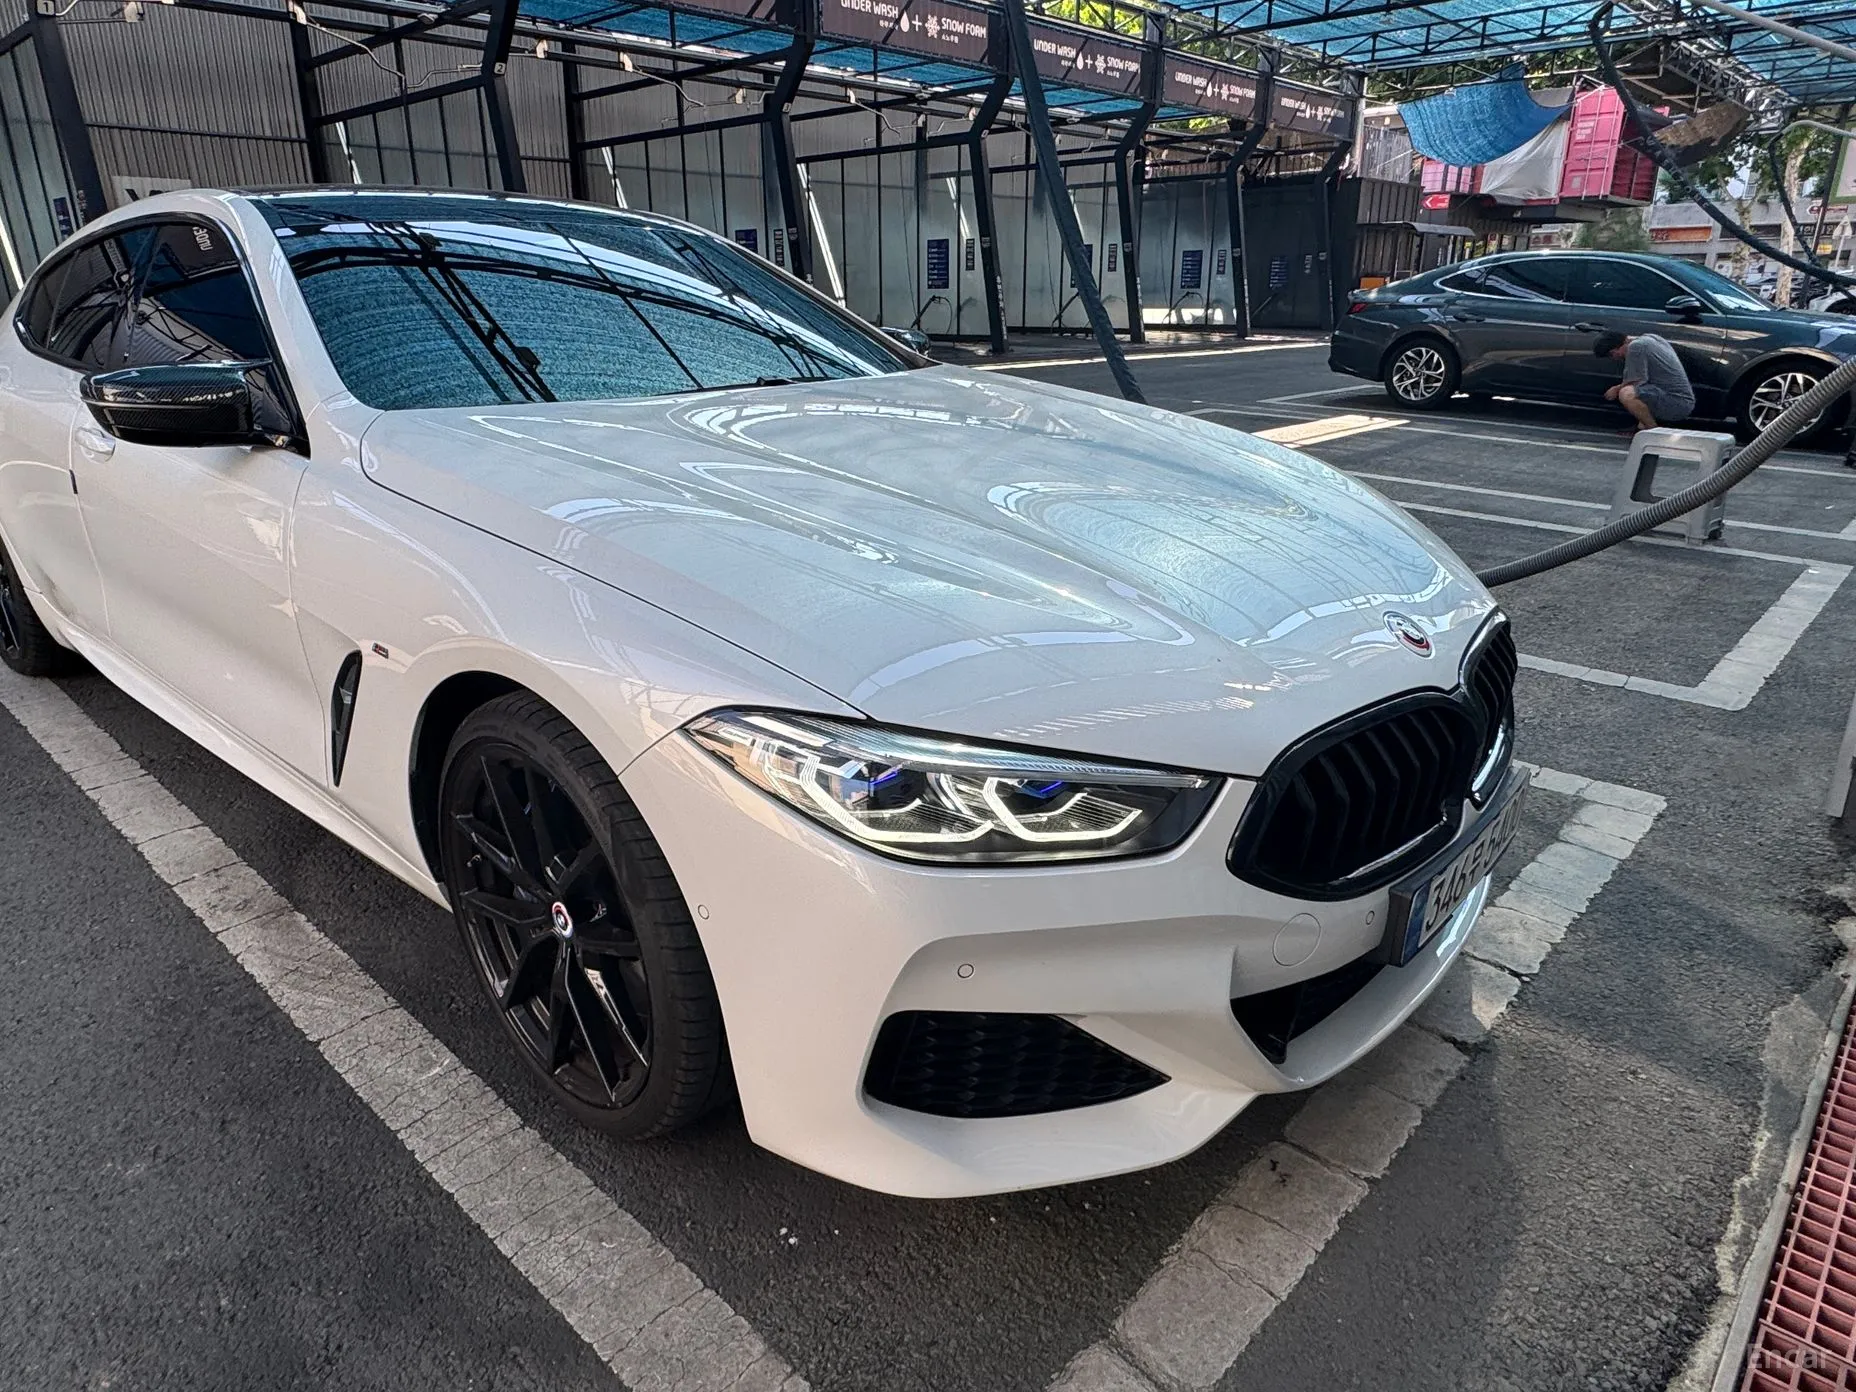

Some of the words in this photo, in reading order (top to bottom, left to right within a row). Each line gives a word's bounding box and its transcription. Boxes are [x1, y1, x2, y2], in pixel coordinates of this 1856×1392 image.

[841, 0, 871, 13] UNDER
[873, 1, 899, 19] WASH
[941, 17, 964, 34] SNOW
[1033, 38, 1056, 54] UNDER
[1057, 44, 1076, 59] WASH
[1107, 56, 1124, 70] SNOW
